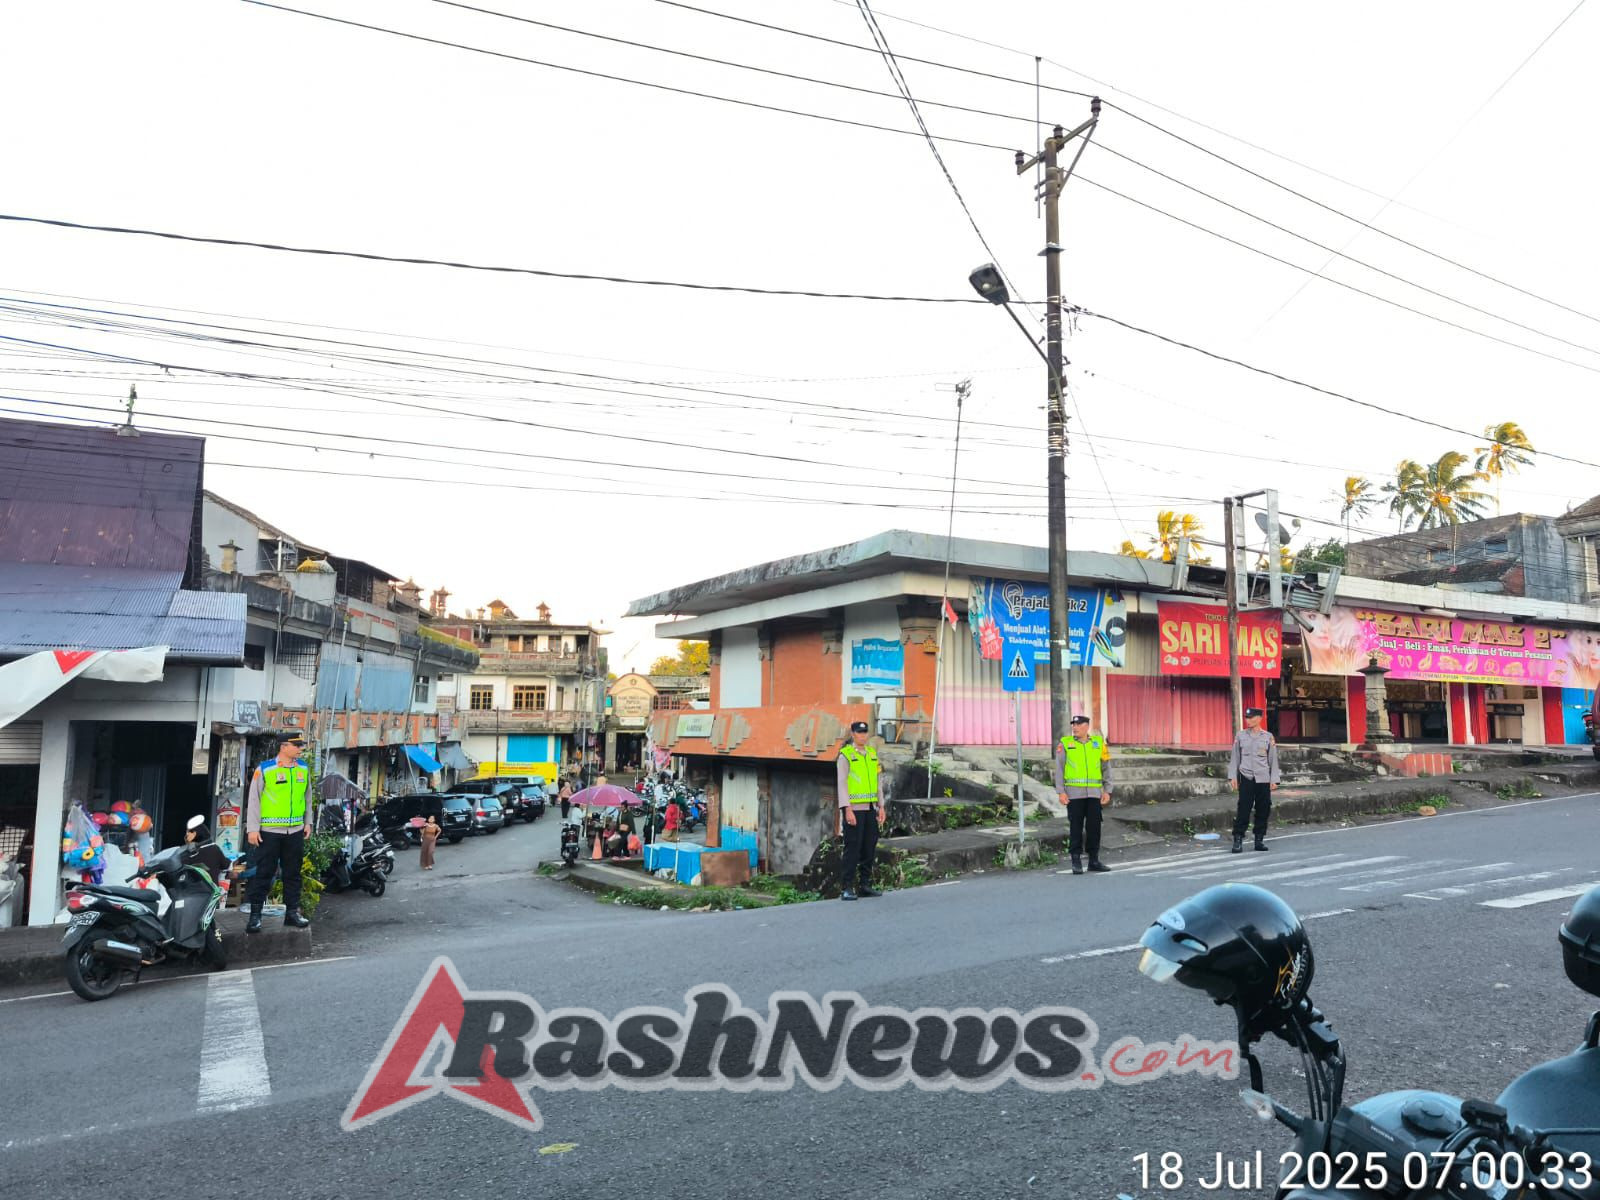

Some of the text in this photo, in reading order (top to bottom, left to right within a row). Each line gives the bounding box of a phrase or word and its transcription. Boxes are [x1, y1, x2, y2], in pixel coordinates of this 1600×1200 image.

[1013, 595, 1088, 612] PrajaLik 2
[1161, 620, 1279, 658] SARI MAS
[1379, 639, 1397, 650] Jual
[1460, 624, 1525, 647] MAS
